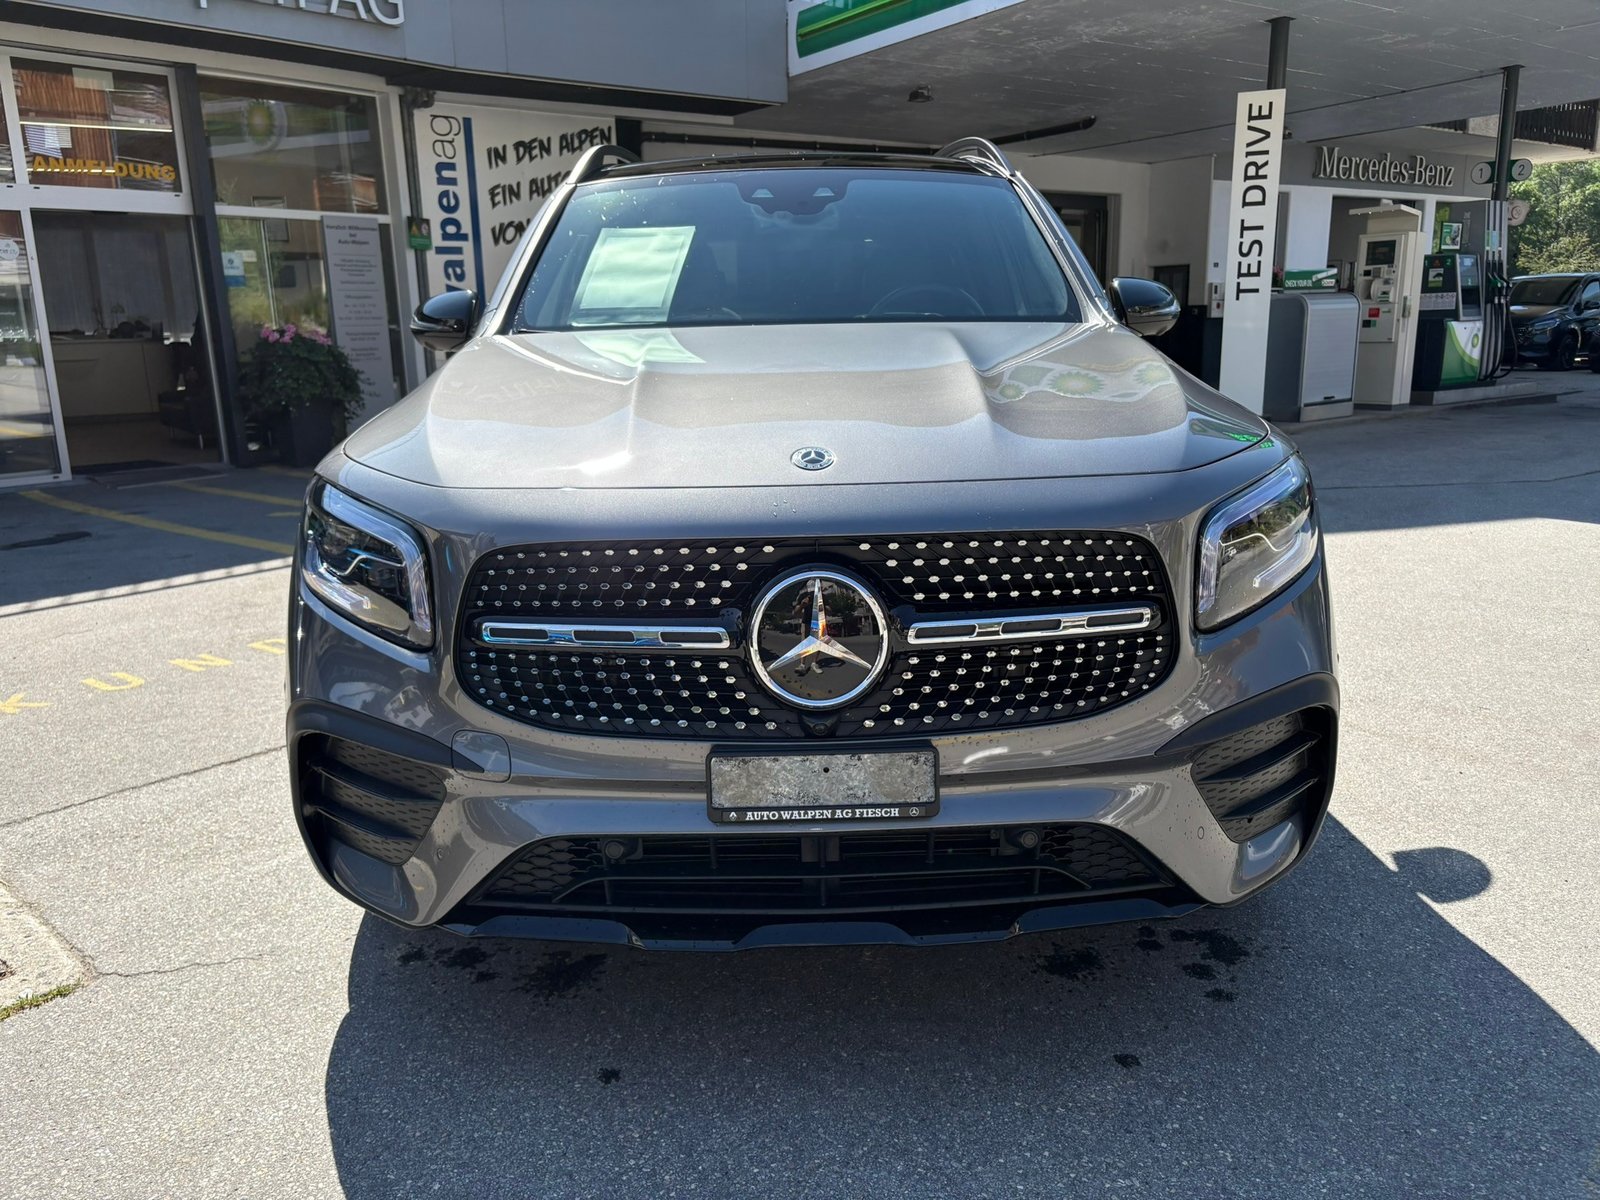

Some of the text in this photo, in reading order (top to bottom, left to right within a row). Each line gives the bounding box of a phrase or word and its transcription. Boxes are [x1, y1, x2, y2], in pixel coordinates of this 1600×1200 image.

[487, 126, 612, 169] IN DEN ALPEN
[32, 156, 177, 181] ANMELDUNG
[1318, 145, 1455, 188] Mercedes-Benz
[1476, 166, 1484, 179] 1
[1517, 163, 1526, 177] 2
[488, 181, 521, 210] EIN
[1235, 100, 1274, 301] TEST DRIVE
[746, 808, 899, 821] AUTO WALPEN AG FIESCH
